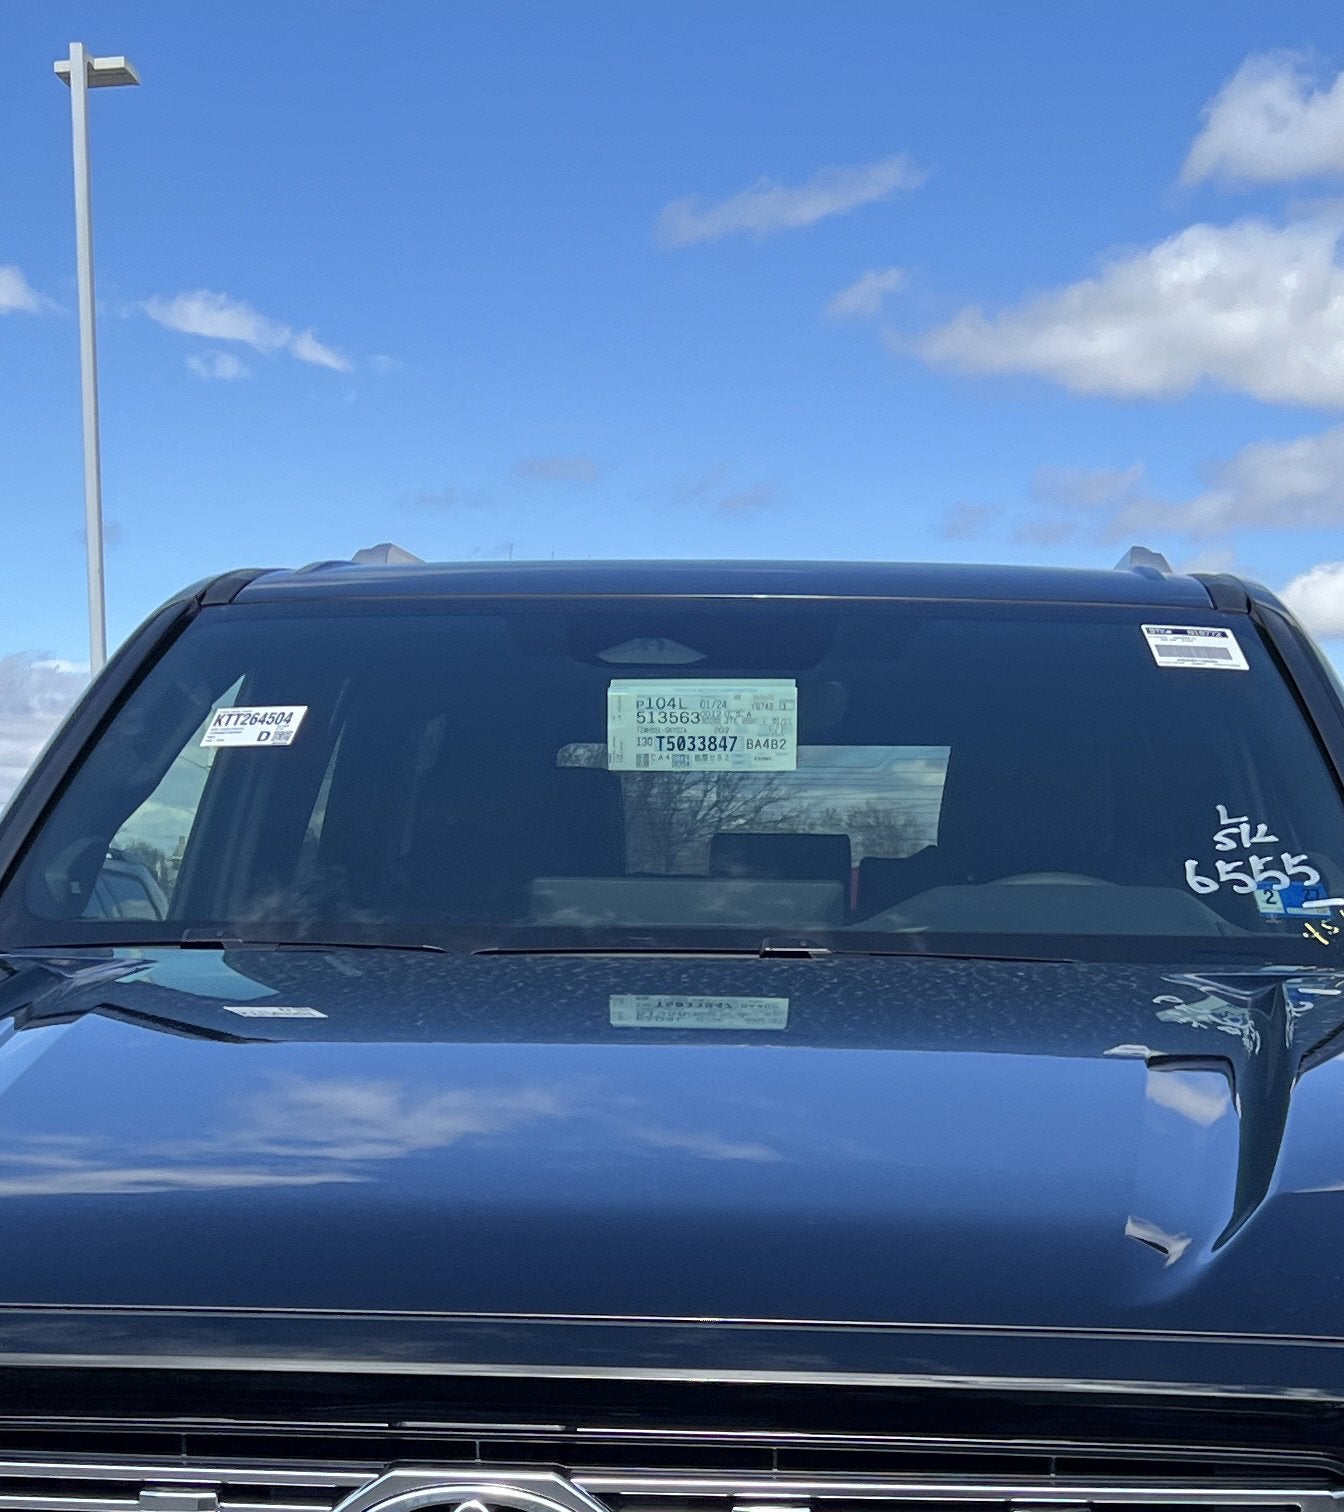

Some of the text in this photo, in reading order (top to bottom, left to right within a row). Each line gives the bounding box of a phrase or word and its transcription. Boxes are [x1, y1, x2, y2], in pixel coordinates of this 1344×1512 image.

[213, 711, 294, 726] KTT264504
[636, 711, 700, 724] 513563
[256, 730, 271, 742] D
[656, 735, 738, 752] T5033847
[1184, 852, 1321, 895] 6555
[1263, 889, 1277, 905] 2
